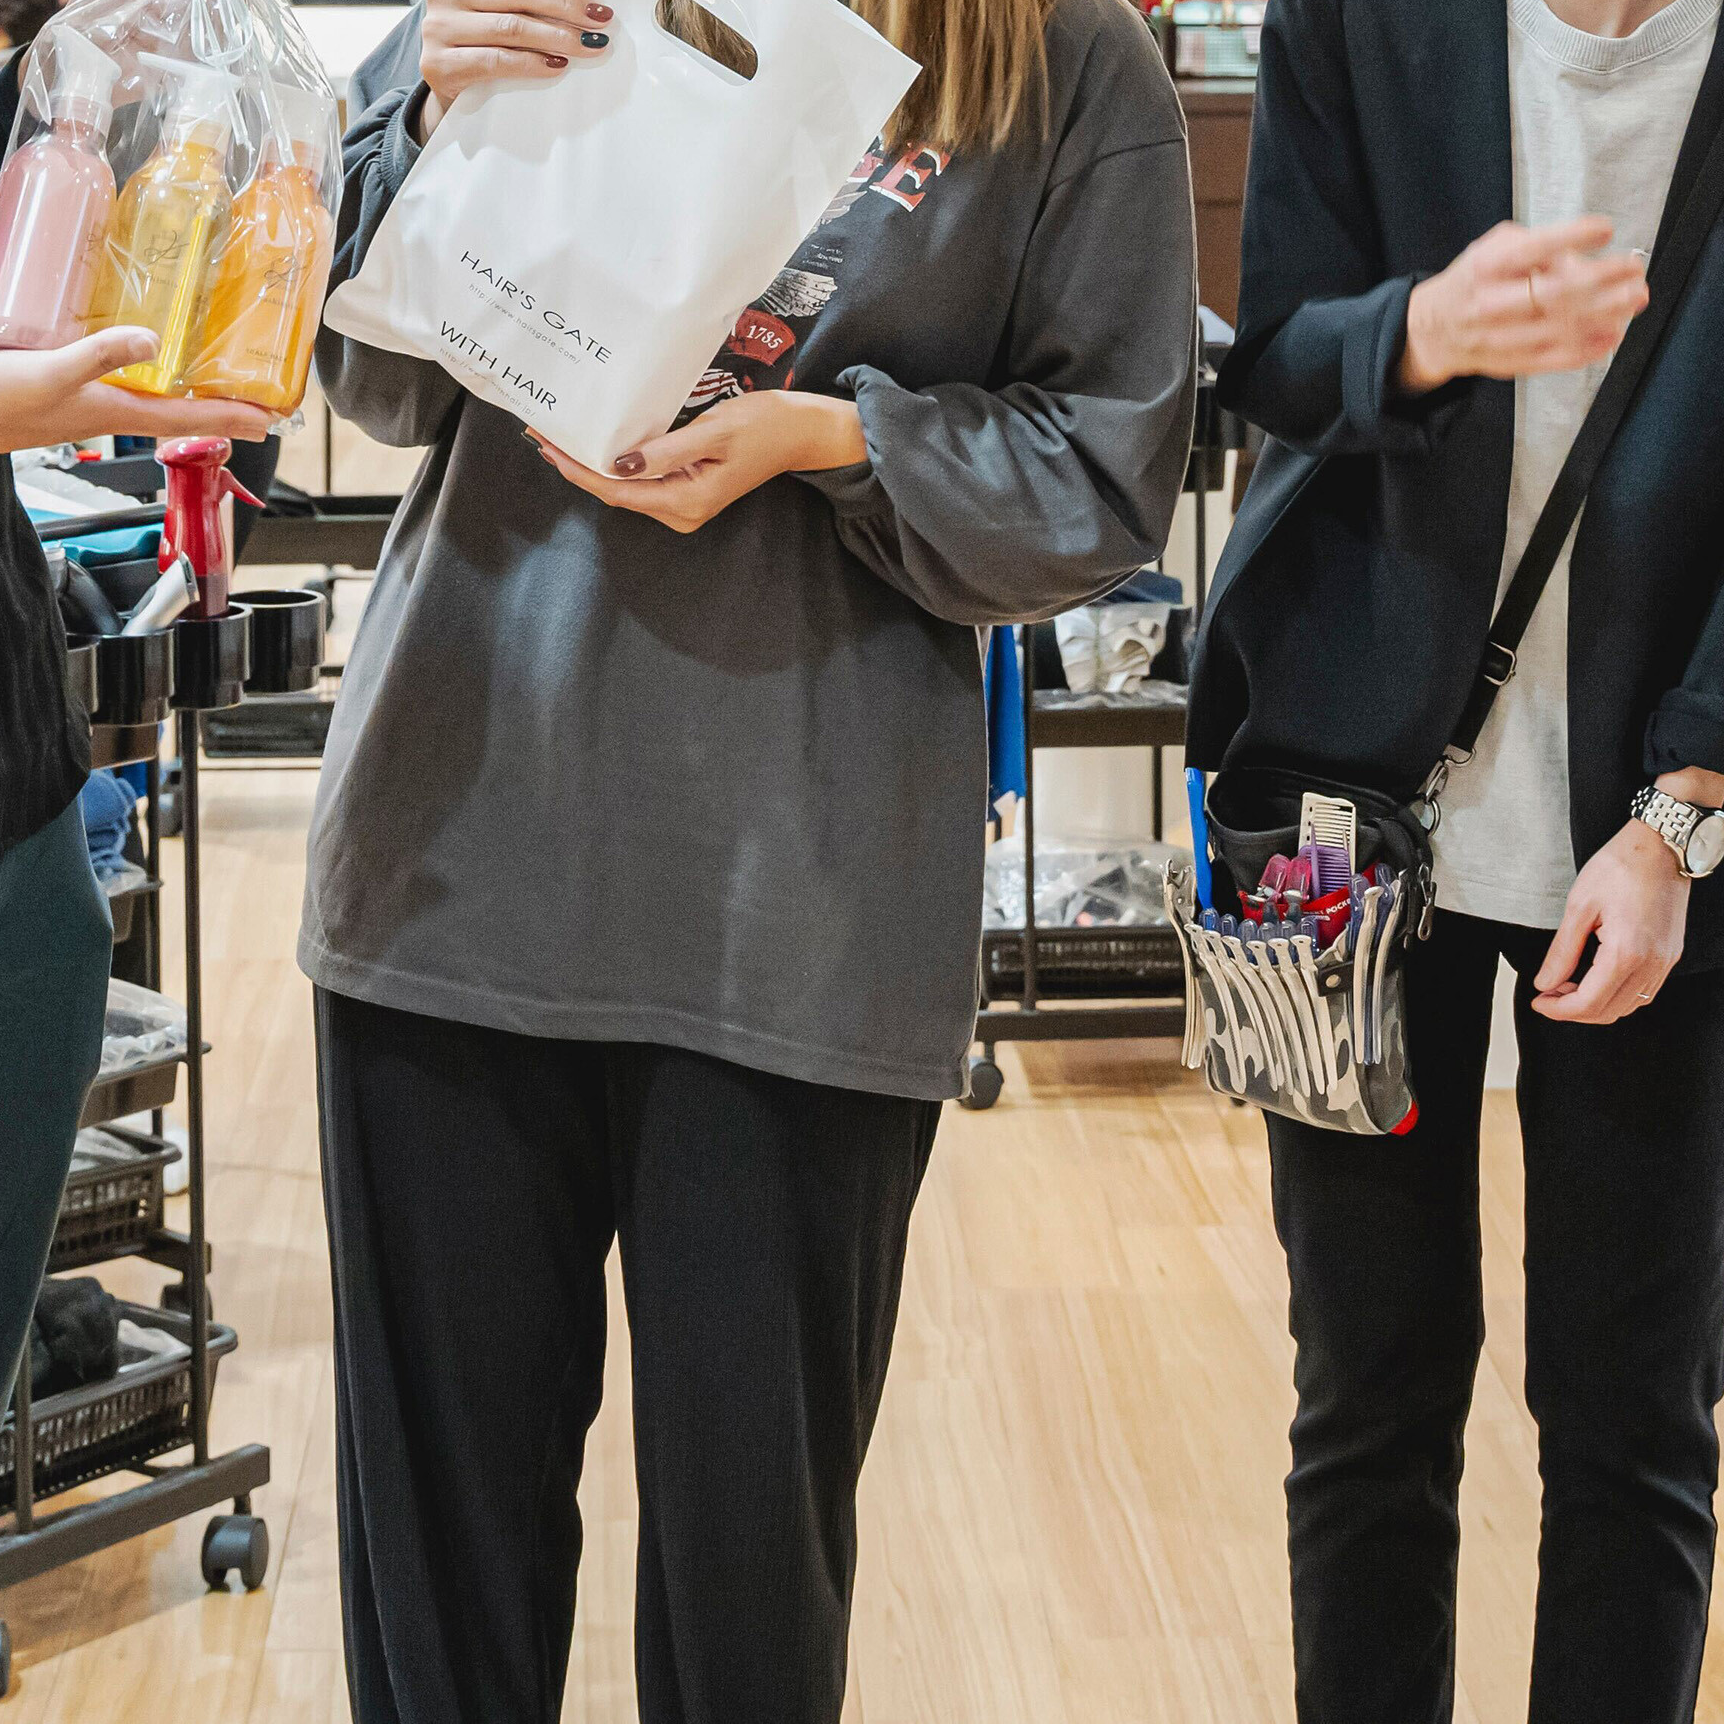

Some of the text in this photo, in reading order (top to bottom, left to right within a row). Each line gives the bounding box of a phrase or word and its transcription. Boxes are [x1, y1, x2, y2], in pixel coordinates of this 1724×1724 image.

[460, 251, 613, 364] HAIR'S GATE
[746, 324, 784, 350] 1785
[440, 320, 557, 412] WITH HAIR
